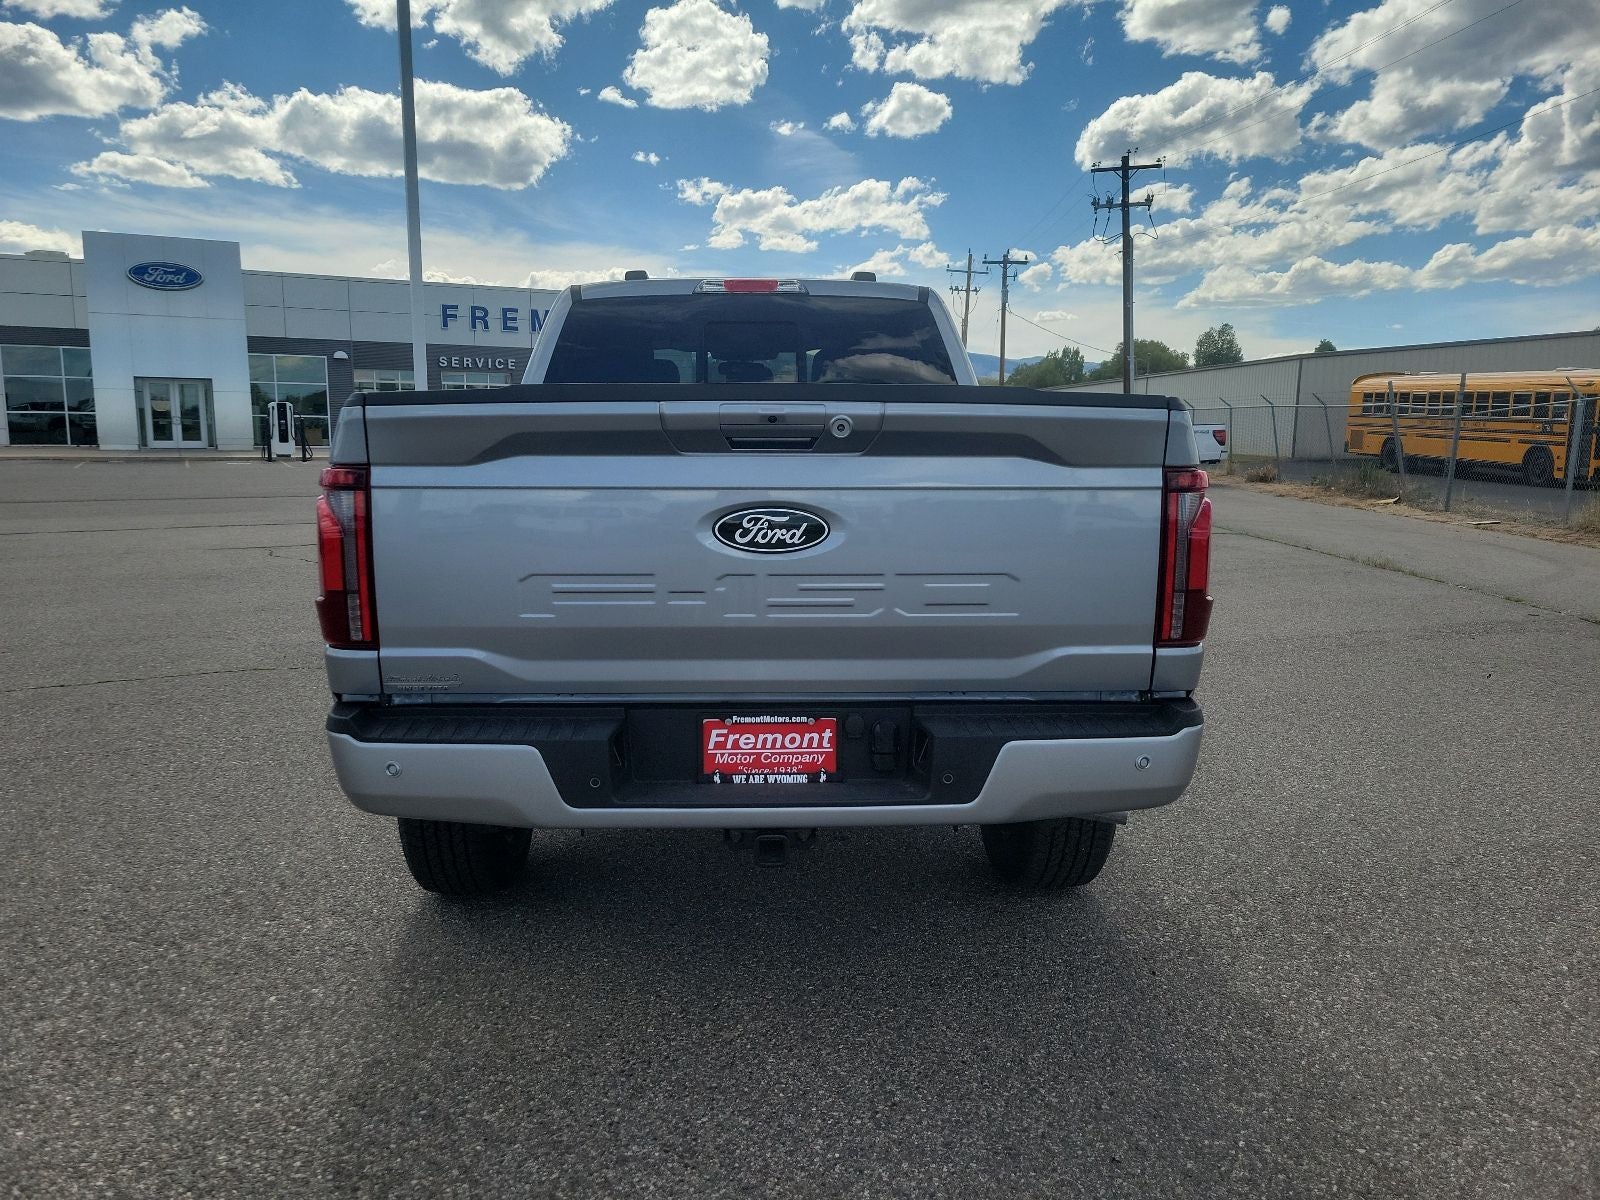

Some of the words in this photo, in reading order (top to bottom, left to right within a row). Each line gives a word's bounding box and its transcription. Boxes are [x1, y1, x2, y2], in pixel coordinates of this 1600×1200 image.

[143, 266, 187, 284] Ford
[439, 356, 517, 370] SERVICE
[734, 514, 808, 544] Ford
[518, 573, 1021, 618] F-150
[732, 715, 808, 724] FremontMotors.com
[707, 728, 833, 750] Fremont
[715, 752, 757, 764] Motor
[760, 752, 826, 765] Company
[732, 774, 747, 784] WE
[748, 774, 765, 784] ARE
[766, 774, 809, 784] WYOMING
